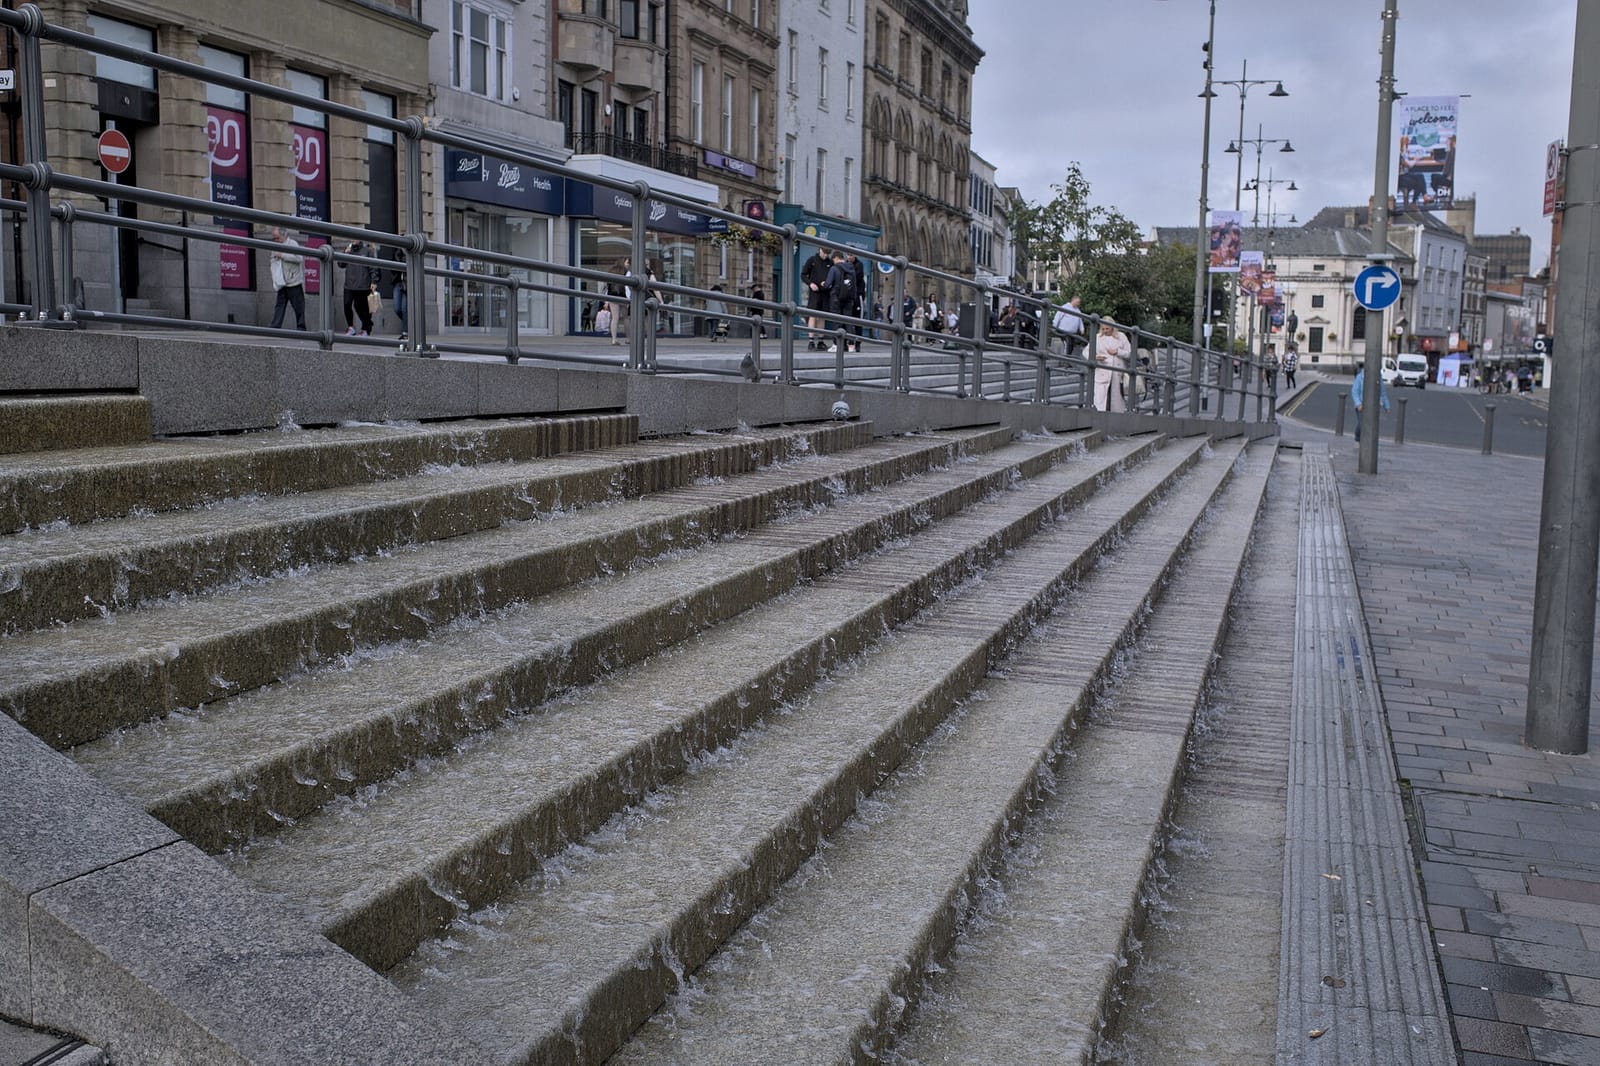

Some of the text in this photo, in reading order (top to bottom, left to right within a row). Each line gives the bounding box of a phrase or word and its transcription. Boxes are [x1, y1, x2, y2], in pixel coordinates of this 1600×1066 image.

[0, 76, 10, 86] ay
[1409, 112, 1455, 126] welcome
[457, 158, 480, 172] Boots
[497, 163, 521, 189] Boots
[533, 176, 552, 191] Health
[1437, 187, 1451, 197] DH
[649, 200, 667, 221] Boots
